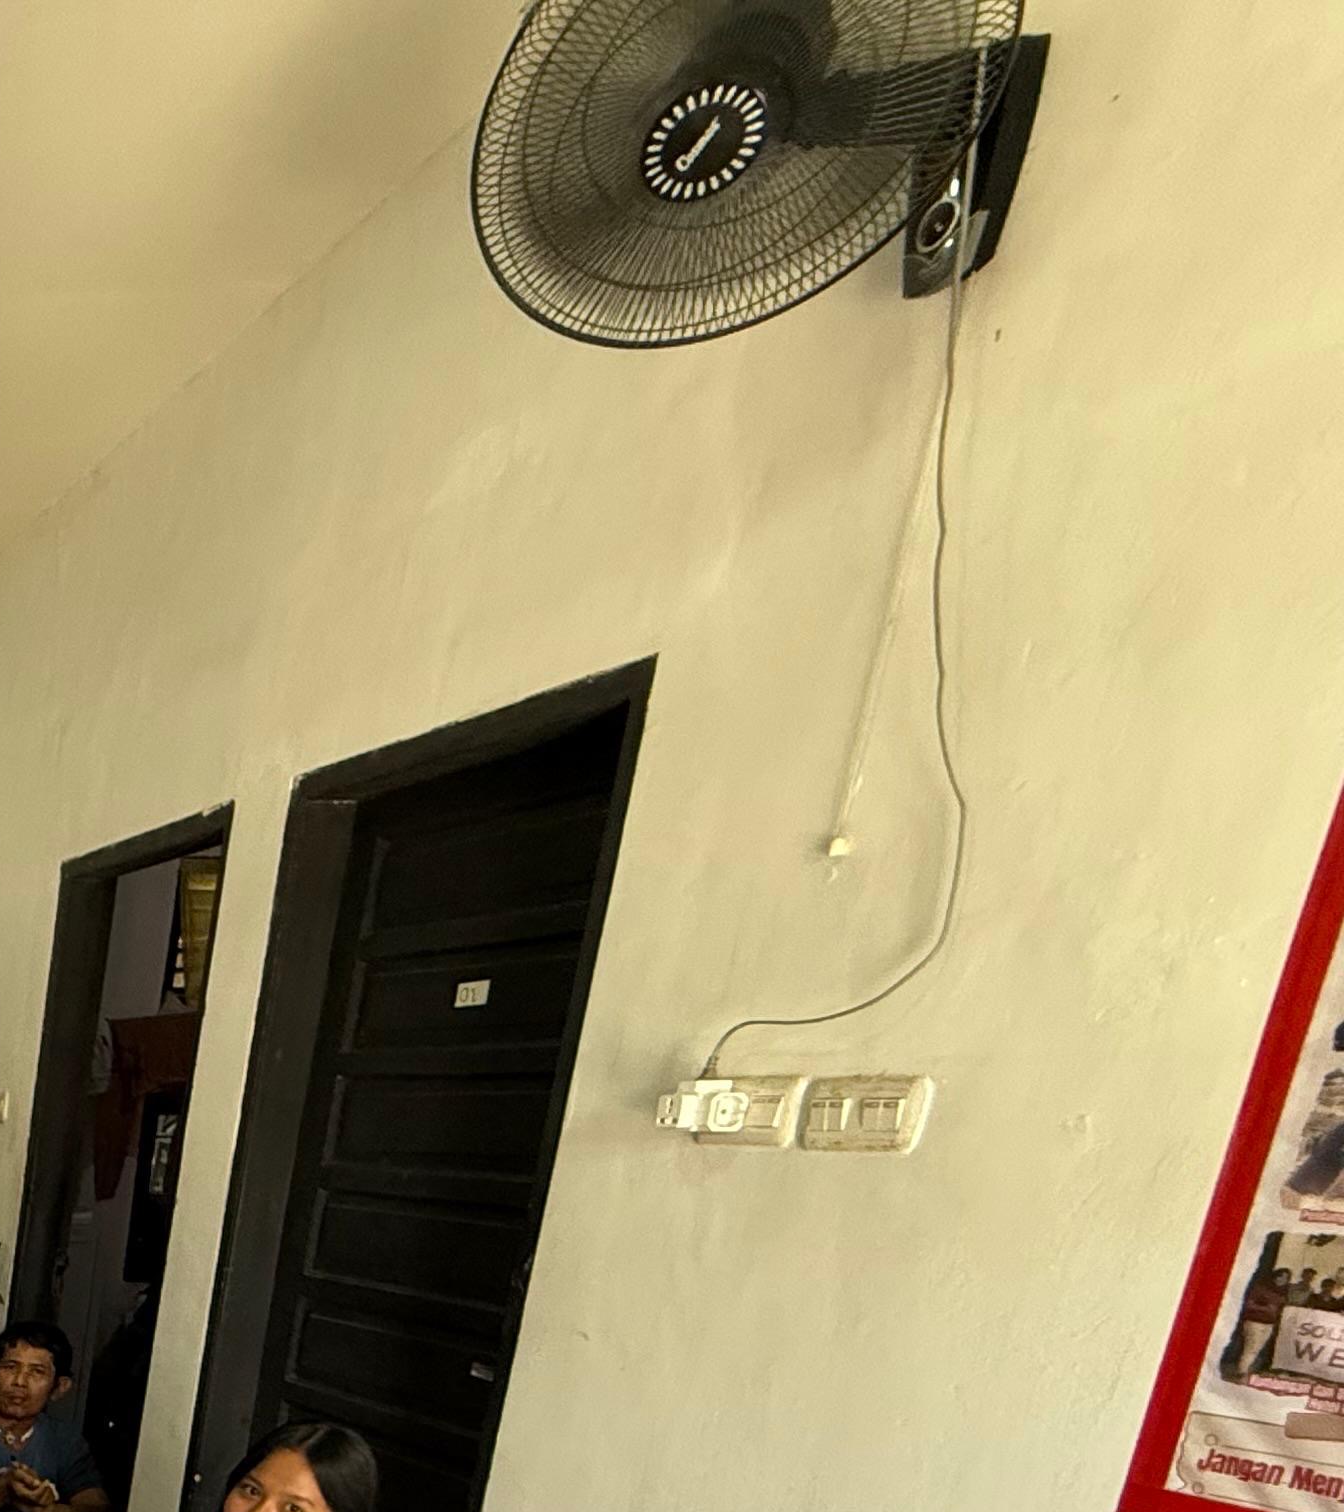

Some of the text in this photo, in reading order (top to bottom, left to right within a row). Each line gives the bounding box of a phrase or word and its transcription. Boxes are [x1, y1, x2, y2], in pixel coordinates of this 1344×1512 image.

[1297, 1321, 1344, 1342] SOL
[1197, 1449, 1344, 1503] Jangan Men
